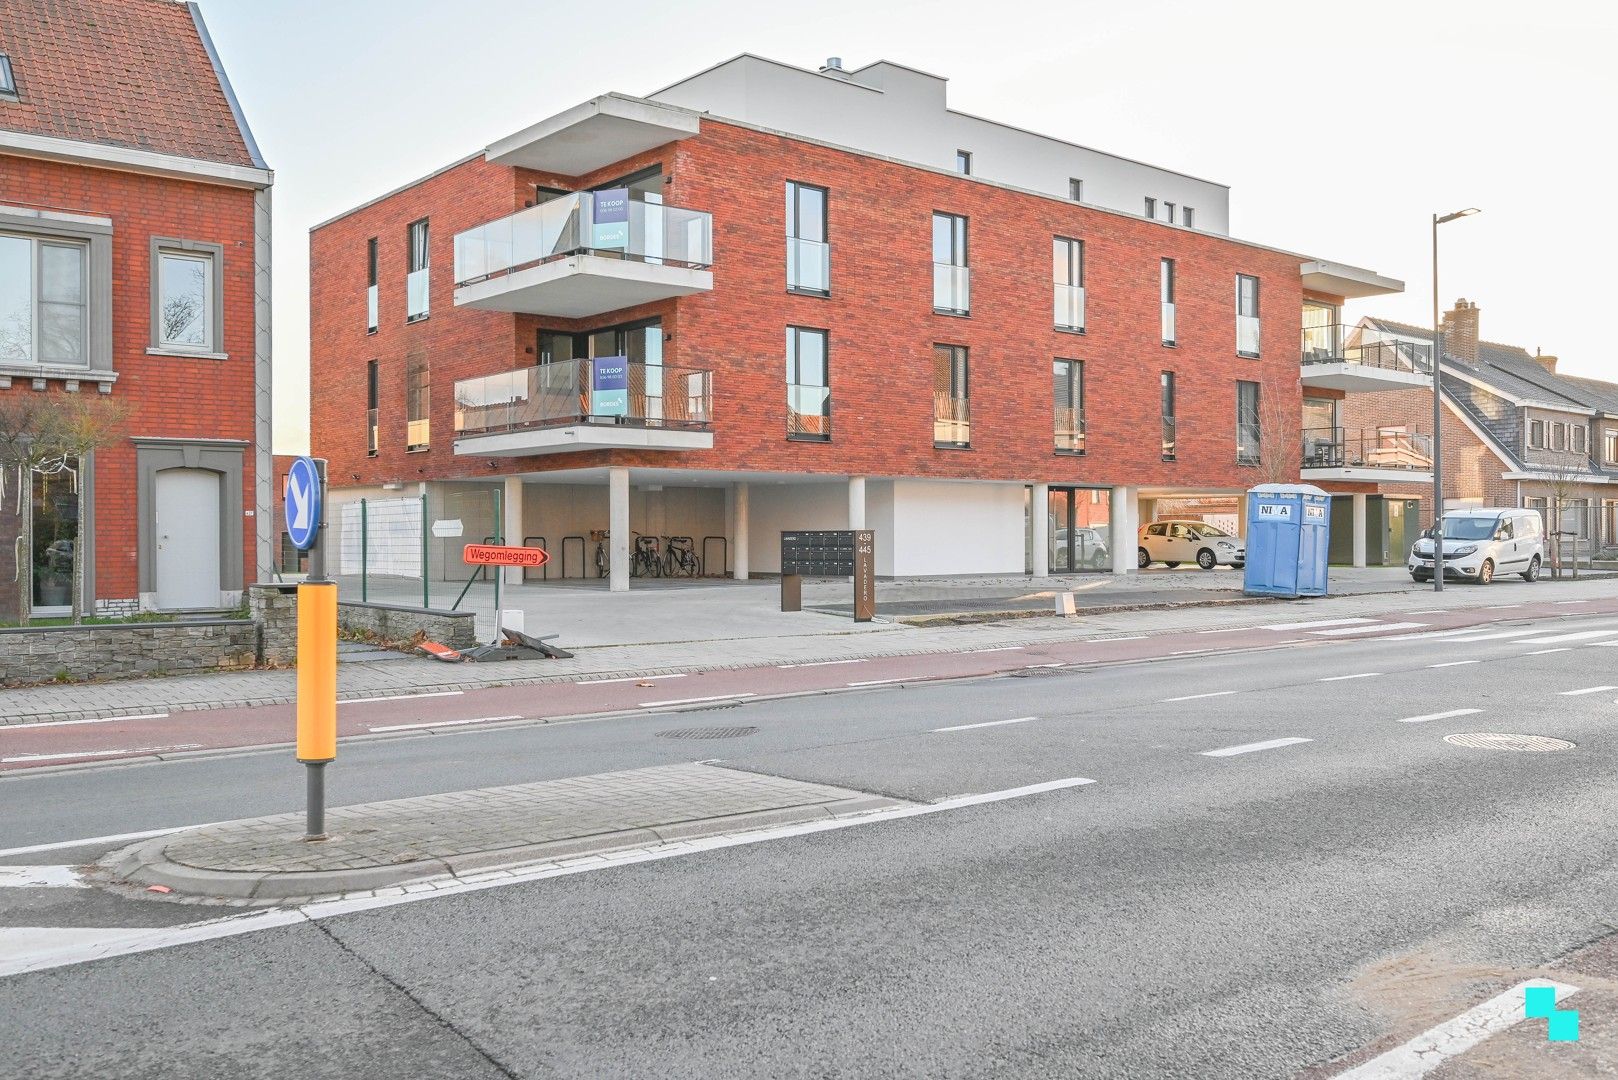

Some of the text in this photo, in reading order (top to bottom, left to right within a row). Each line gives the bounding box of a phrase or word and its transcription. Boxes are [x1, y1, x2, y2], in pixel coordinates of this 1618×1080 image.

[858, 533, 872, 542] 439
[858, 546, 872, 554] 445
[470, 548, 538, 563] Wegomlegging
